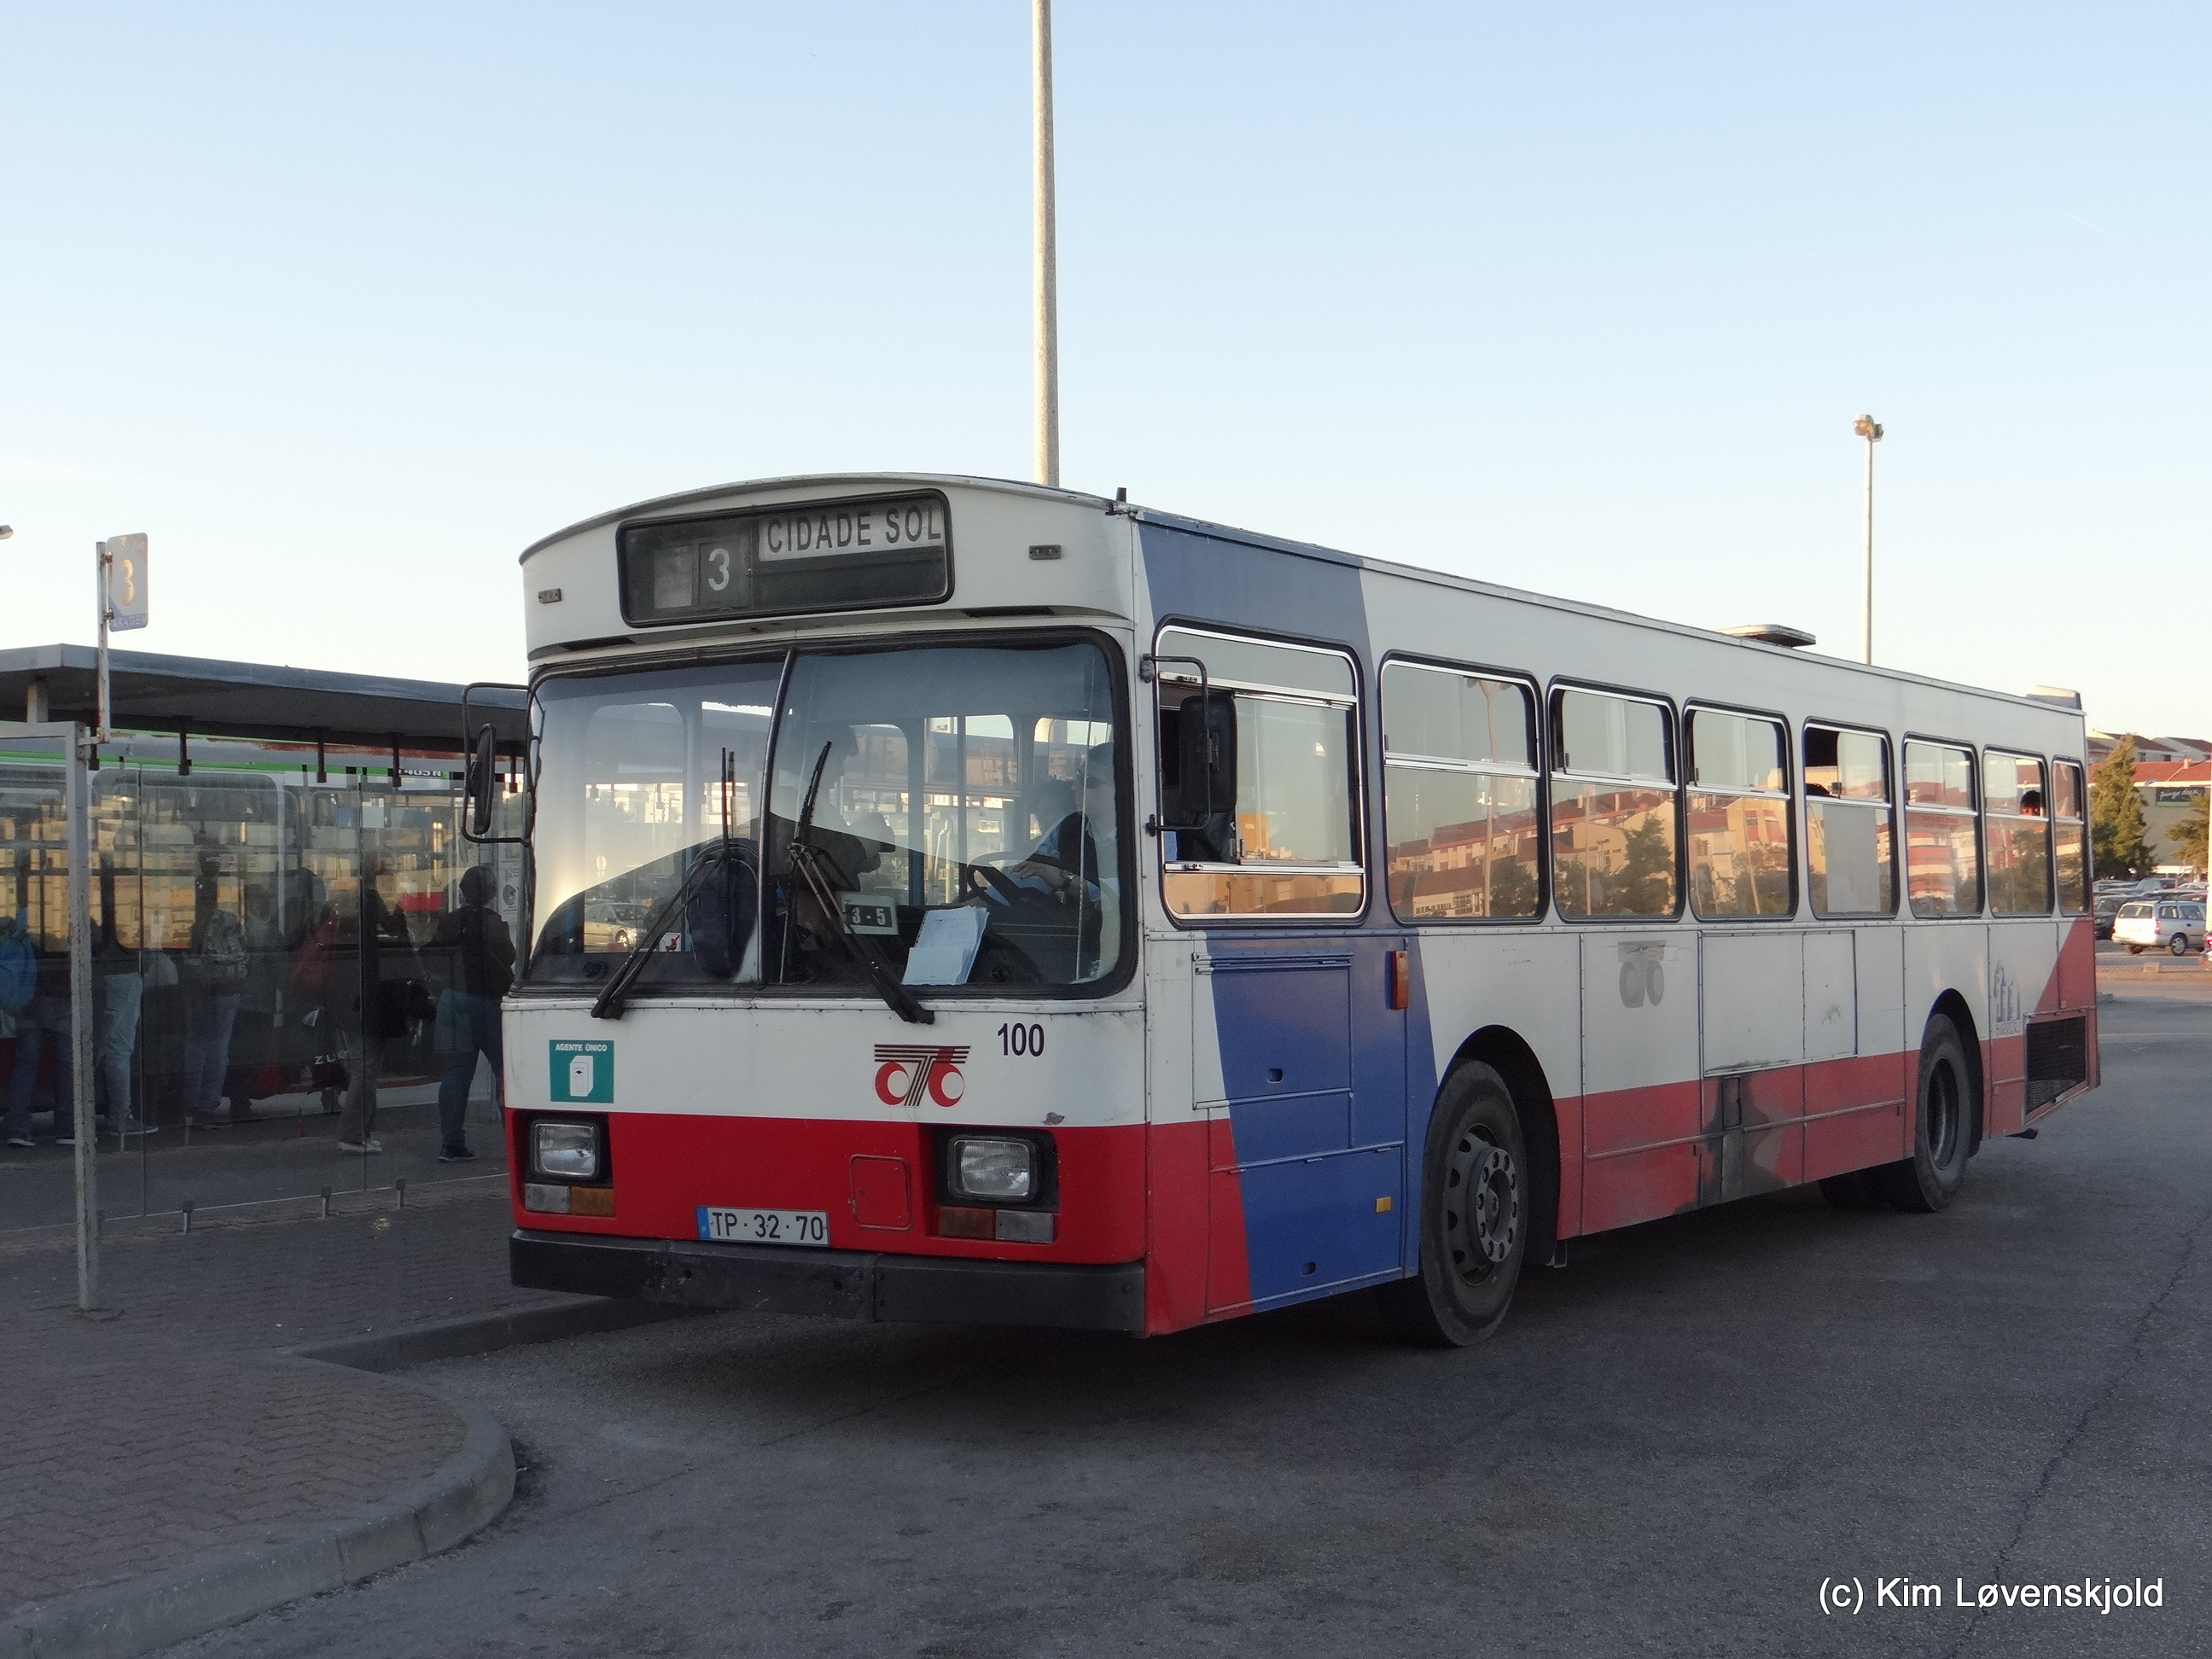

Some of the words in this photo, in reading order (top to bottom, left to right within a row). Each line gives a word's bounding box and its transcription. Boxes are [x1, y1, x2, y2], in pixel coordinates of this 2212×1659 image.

[766, 510, 871, 553] CIDADE
[884, 504, 941, 544] SOL
[119, 559, 134, 606] 3
[707, 548, 731, 592] 3
[555, 1043, 583, 1051] AGENTE
[585, 1043, 608, 1052] ÚNICO
[997, 1021, 1045, 1057] 100
